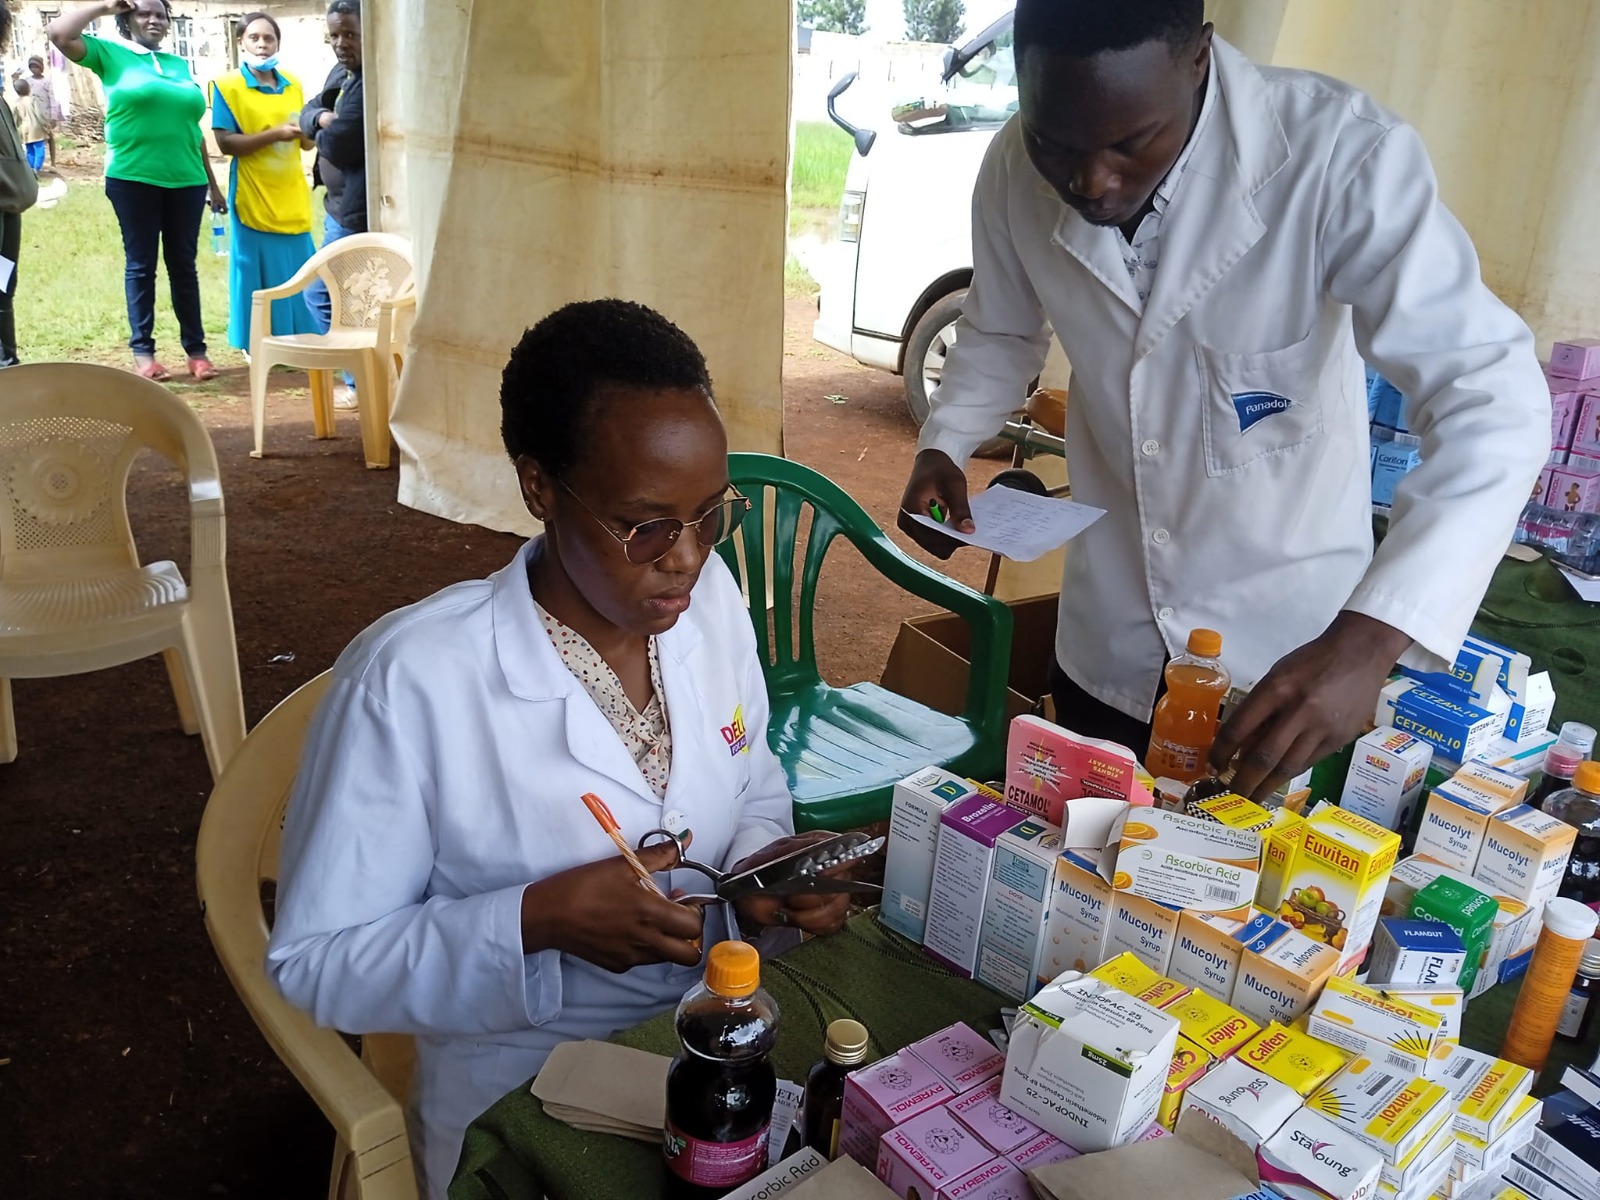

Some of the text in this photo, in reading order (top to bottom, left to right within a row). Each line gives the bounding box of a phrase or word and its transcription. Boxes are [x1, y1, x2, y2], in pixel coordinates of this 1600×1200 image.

[1245, 399, 1287, 415] Panadol
[1411, 688, 1479, 719] CETZAN-10
[1395, 715, 1461, 750] CETZAN-10
[1088, 758, 1125, 775] PAIN FAST
[1092, 765, 1119, 778] FIGHTS
[1008, 785, 1049, 814] CETAMOL
[1452, 780, 1493, 801] Mucolyt
[960, 802, 998, 822] Brozelin
[1332, 809, 1389, 838] Euvitan
[1428, 812, 1472, 840] Mucolyt
[1162, 813, 1222, 834] Ascorbic
[1226, 829, 1257, 843] Acid
[1175, 825, 1208, 837] Ascorbic
[1210, 833, 1227, 842] Acid
[1303, 833, 1360, 874] Euvitan
[1448, 836, 1468, 851] Syrup
[1488, 837, 1530, 868] Mucolyt
[1164, 854, 1241, 881] Ascorbic Acid
[1507, 863, 1526, 879] Syrup
[1059, 880, 1102, 910] Mucolyt
[1080, 907, 1100, 924] Syrup
[1118, 908, 1164, 940] Mucolyt
[1413, 906, 1464, 937] Cond
[1140, 936, 1161, 953] Syrup
[1180, 936, 1229, 971] Mucolyt
[1292, 943, 1324, 968] Mucolyt
[1203, 966, 1226, 984] Syrup
[1139, 981, 1176, 1003] Calfe
[1244, 973, 1297, 1010] Mucolyt
[1351, 989, 1415, 1020] Tanzol
[1098, 1003, 1126, 1020] Capsules
[1134, 1020, 1154, 1034] 25mg
[1269, 1004, 1293, 1023] Syrup
[1205, 1018, 1248, 1045] Calfen
[1086, 1051, 1108, 1067] 25mg
[1247, 1030, 1289, 1063] Calfen
[956, 1056, 1006, 1084] PYREMOL
[1168, 1050, 1197, 1078] Calfe
[889, 1084, 945, 1114] PYREMOL
[955, 1083, 1001, 1111] PYREMO
[1039, 1082, 1066, 1101] Capsules
[1469, 1069, 1505, 1103] Tanzol
[1026, 1087, 1090, 1128] INDOPAC-25
[1065, 1095, 1107, 1125] Indomethacin
[1378, 1087, 1421, 1124] Tanzol
[893, 1130, 945, 1180] PYREMOL
[1014, 1133, 1058, 1164] PYREM
[747, 1171, 792, 1200] corbic
[788, 1154, 820, 1180] Acid
[950, 1163, 1008, 1198] PYREMOL
